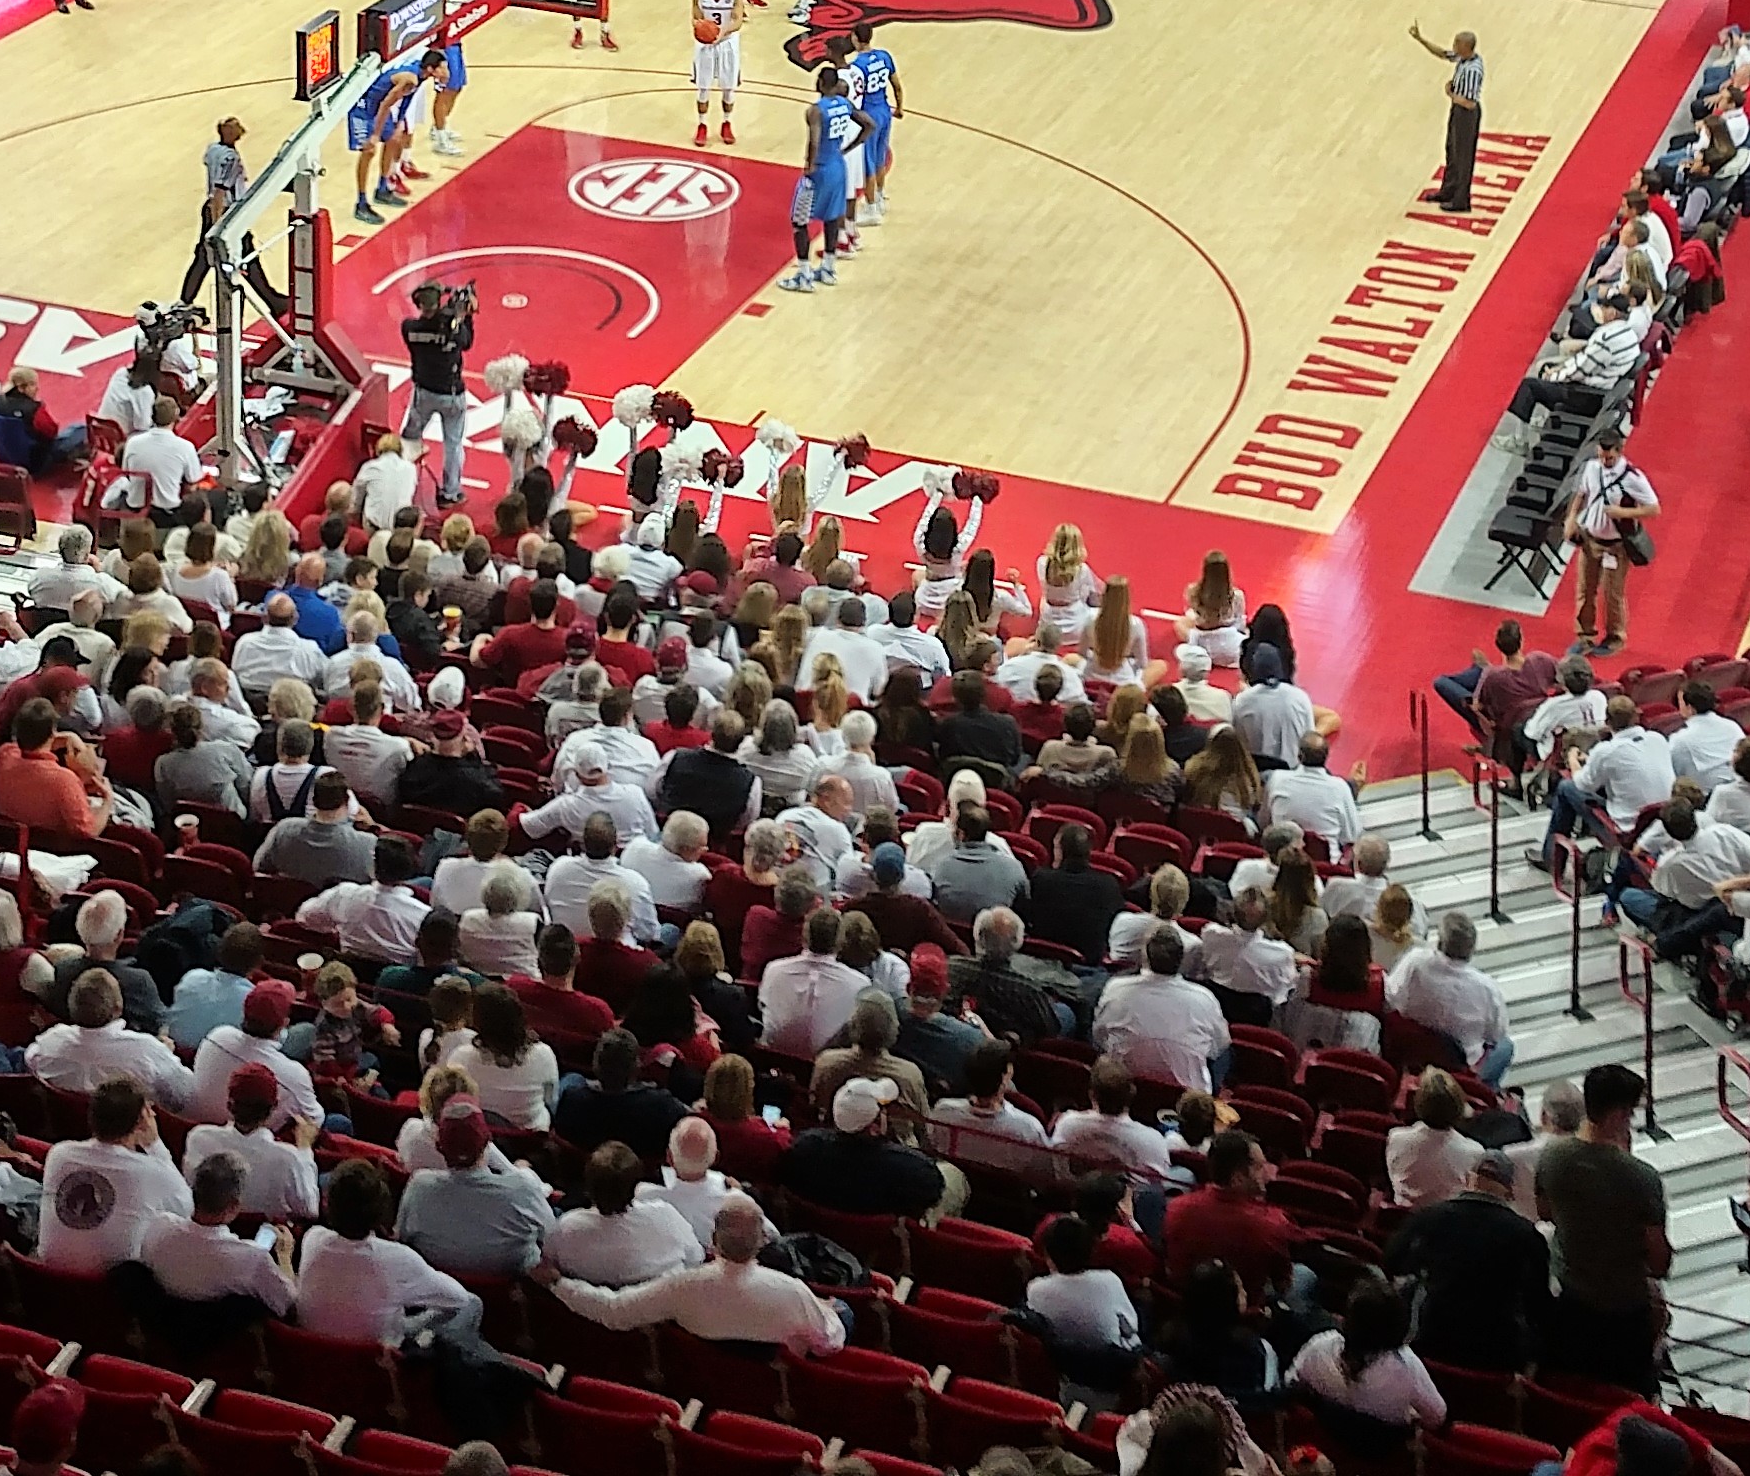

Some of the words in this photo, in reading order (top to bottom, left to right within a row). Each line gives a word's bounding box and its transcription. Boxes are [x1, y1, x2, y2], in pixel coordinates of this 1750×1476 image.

[581, 165, 727, 214] SEC
[1286, 240, 1476, 398] WALTON
[1213, 414, 1363, 511] BUD
